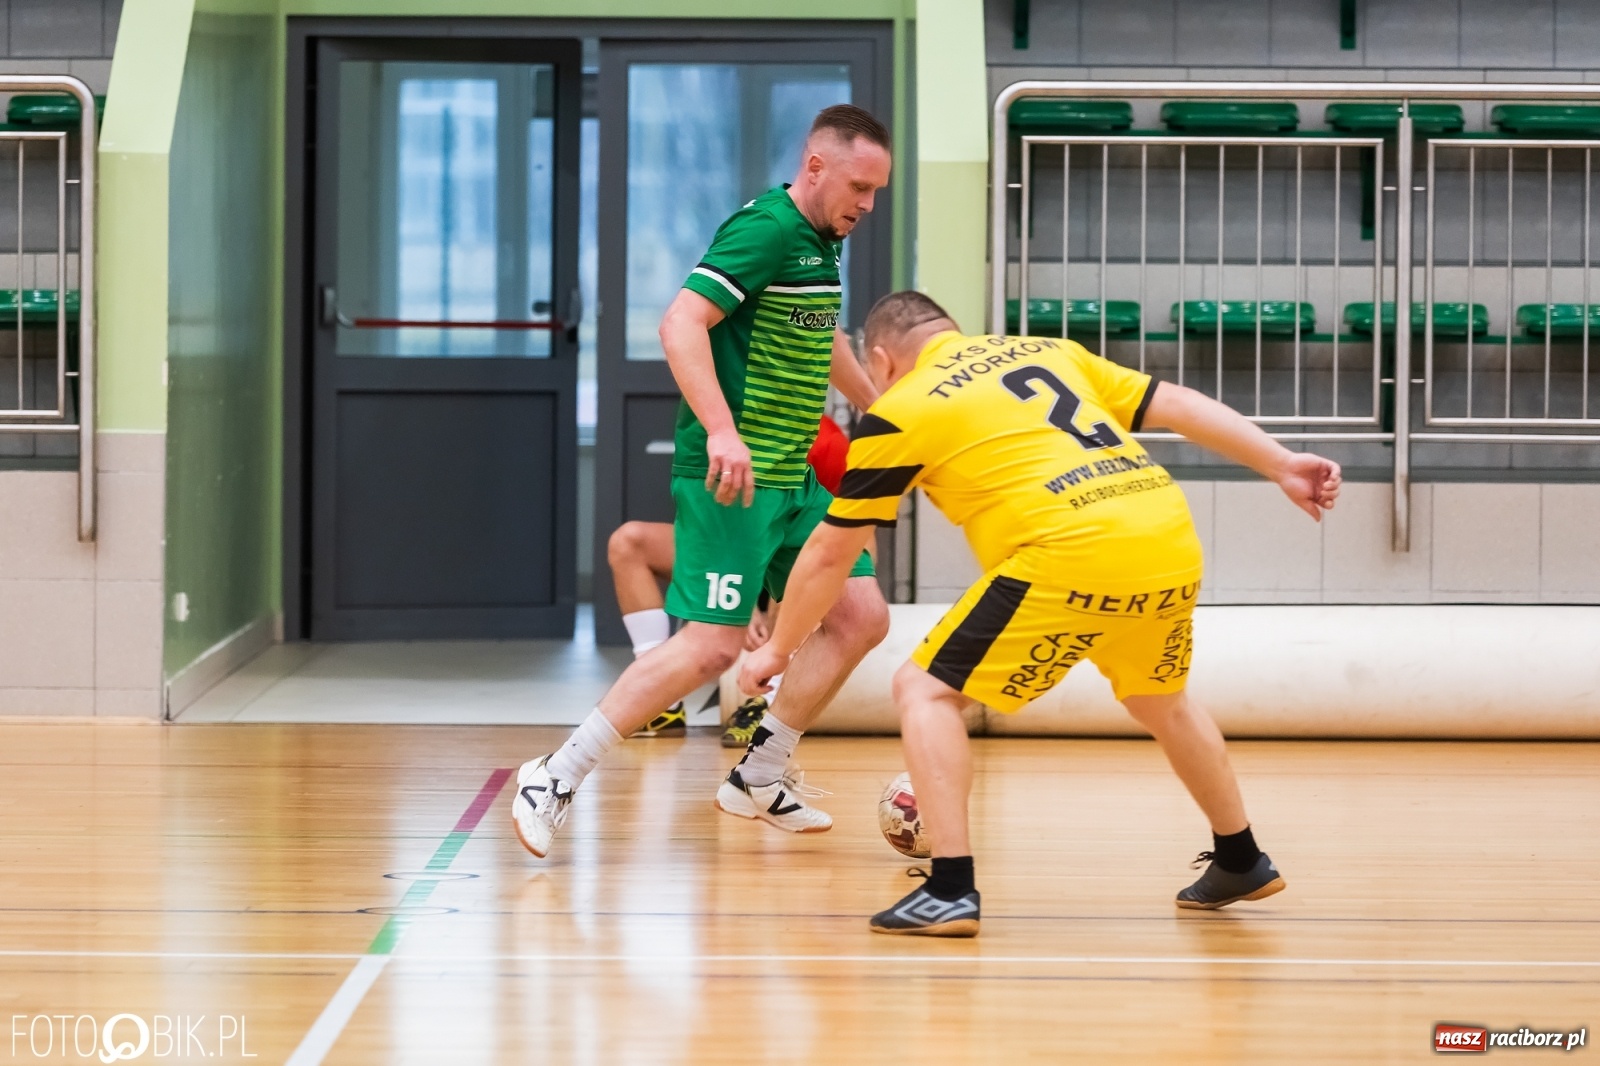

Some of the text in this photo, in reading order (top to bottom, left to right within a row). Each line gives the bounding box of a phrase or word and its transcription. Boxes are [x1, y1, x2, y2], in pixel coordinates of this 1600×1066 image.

[934, 344, 986, 370] LKS
[1001, 364, 1125, 451] 2
[705, 572, 743, 610] 16
[1000, 632, 1071, 699] PRACA
